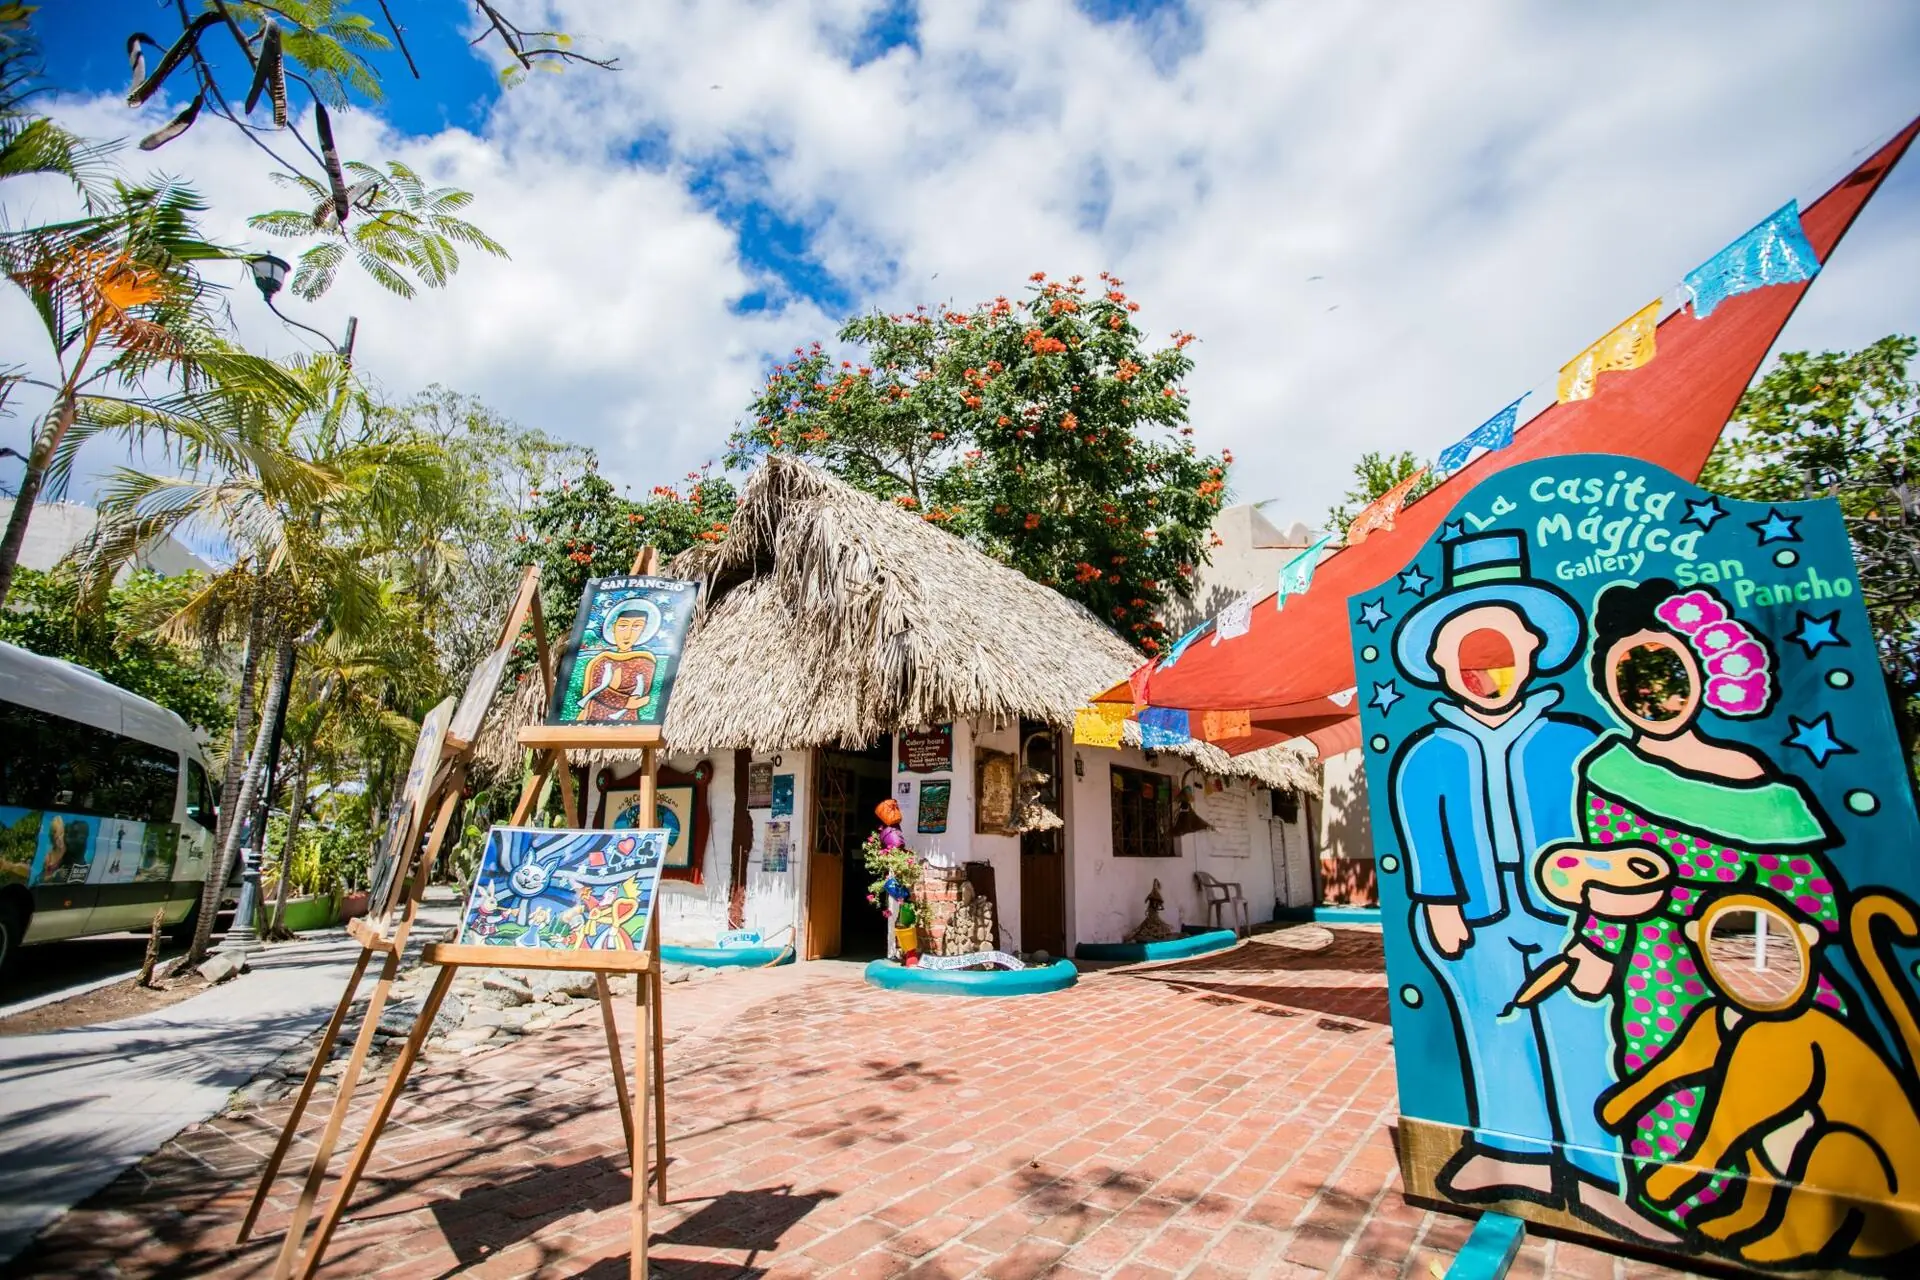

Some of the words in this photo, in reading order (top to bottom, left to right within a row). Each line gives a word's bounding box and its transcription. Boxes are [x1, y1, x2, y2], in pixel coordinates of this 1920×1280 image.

[1465, 495, 1517, 531] La
[1529, 471, 1676, 520] Casita
[1537, 508, 1704, 561] Mágica
[1556, 550, 1646, 581] Gallery
[1675, 558, 1744, 587] San
[600, 579, 626, 590] SAN
[628, 578, 685, 592] PANCHO
[1735, 576, 1853, 608] Pancho
